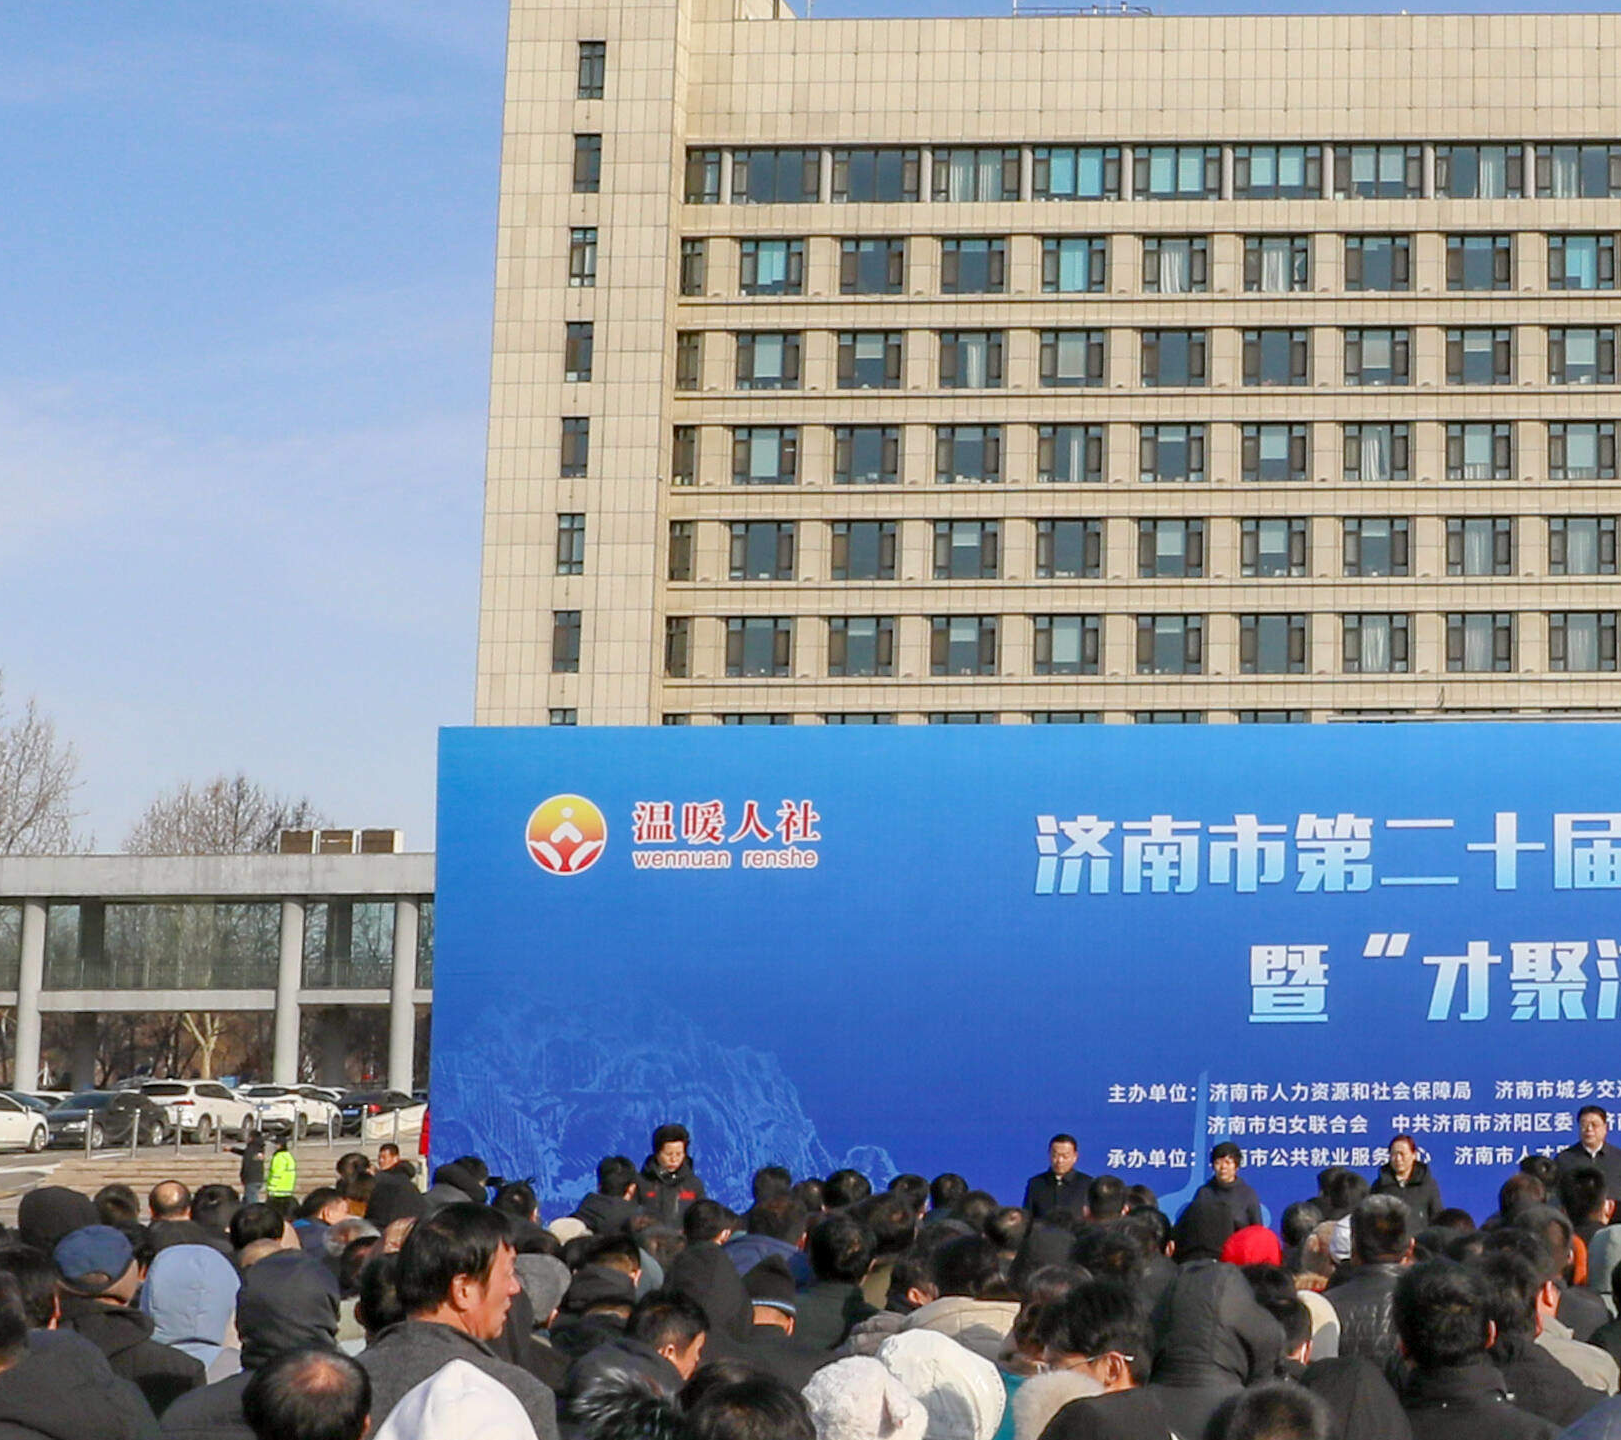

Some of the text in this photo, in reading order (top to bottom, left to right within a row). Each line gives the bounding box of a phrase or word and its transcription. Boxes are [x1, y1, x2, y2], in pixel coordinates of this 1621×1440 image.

[632, 800, 821, 845] 温暖人社
[633, 846, 819, 869] wennuan renshe
[1207, 1114, 1368, 1135] 济南市妇女联合会
[1391, 1111, 1574, 1134] 中共济南市济阳区委
